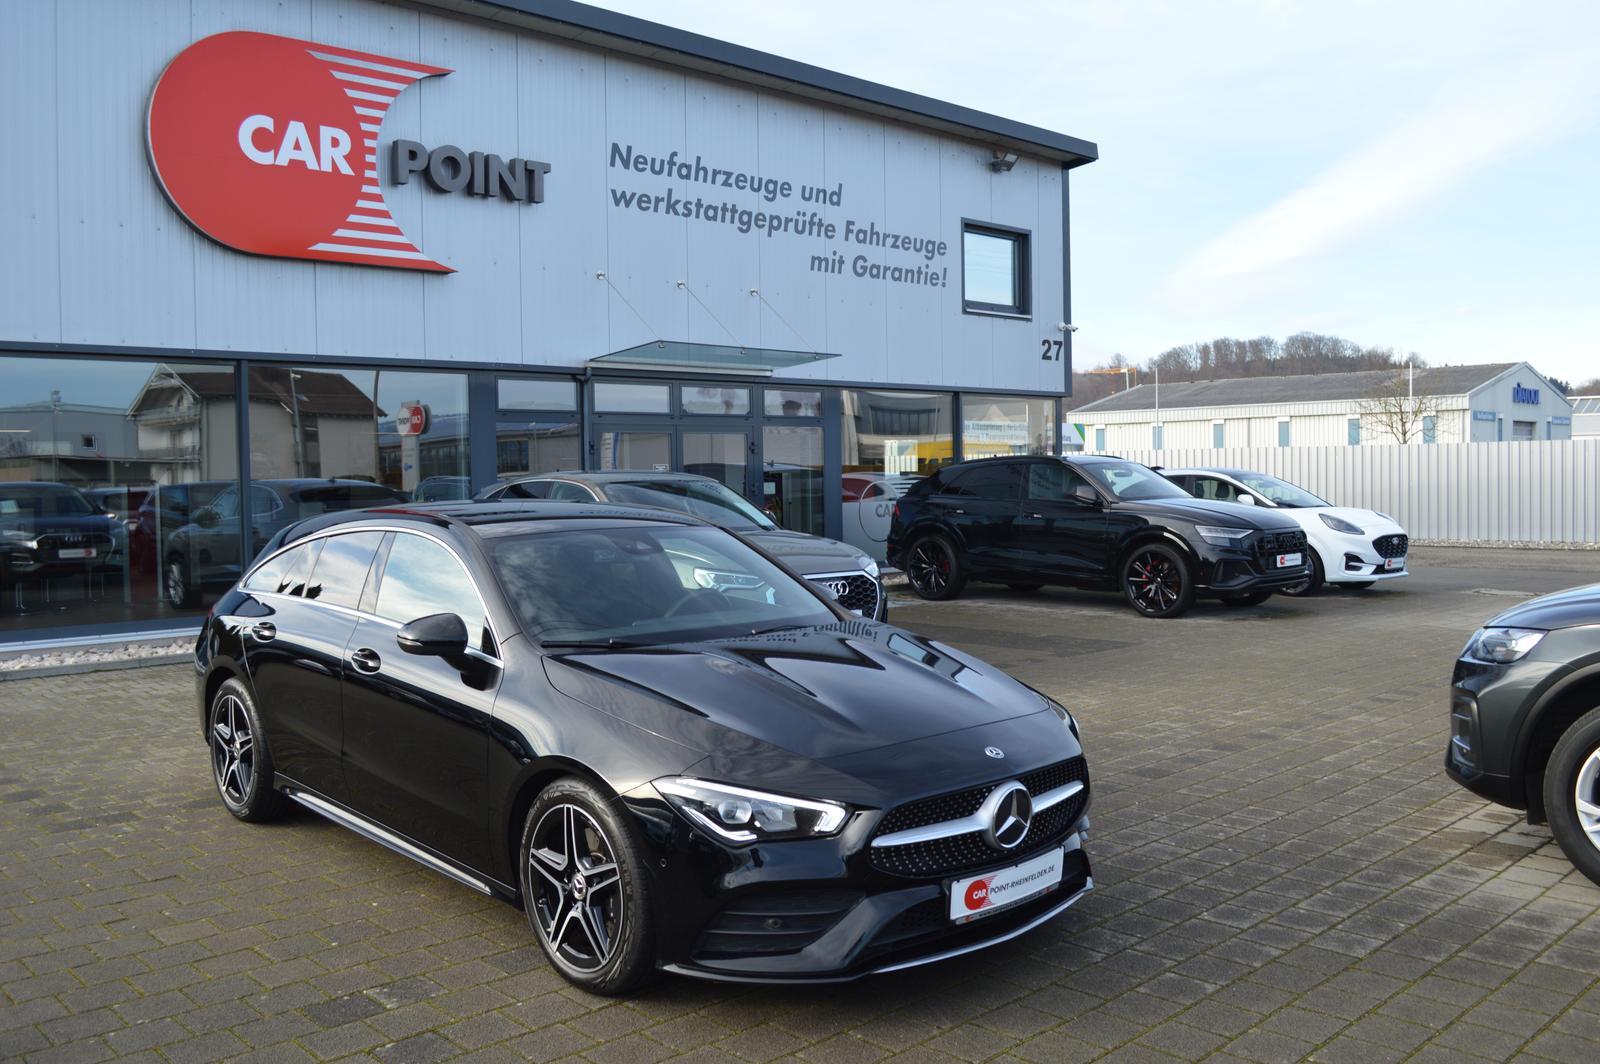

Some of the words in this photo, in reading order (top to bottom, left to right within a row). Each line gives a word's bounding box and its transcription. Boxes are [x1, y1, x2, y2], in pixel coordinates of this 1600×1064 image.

[238, 114, 355, 176] CAR
[392, 139, 551, 204] POINT
[610, 142, 793, 202] Neufahrzeuge
[801, 183, 843, 207] und
[611, 188, 836, 237] werkstattgeprüfte
[844, 220, 947, 260] Fahrzeuge
[810, 250, 845, 275] mit
[852, 255, 947, 288] Garantie!
[1041, 339, 1063, 361] 27
[972, 889, 987, 899] CAR
